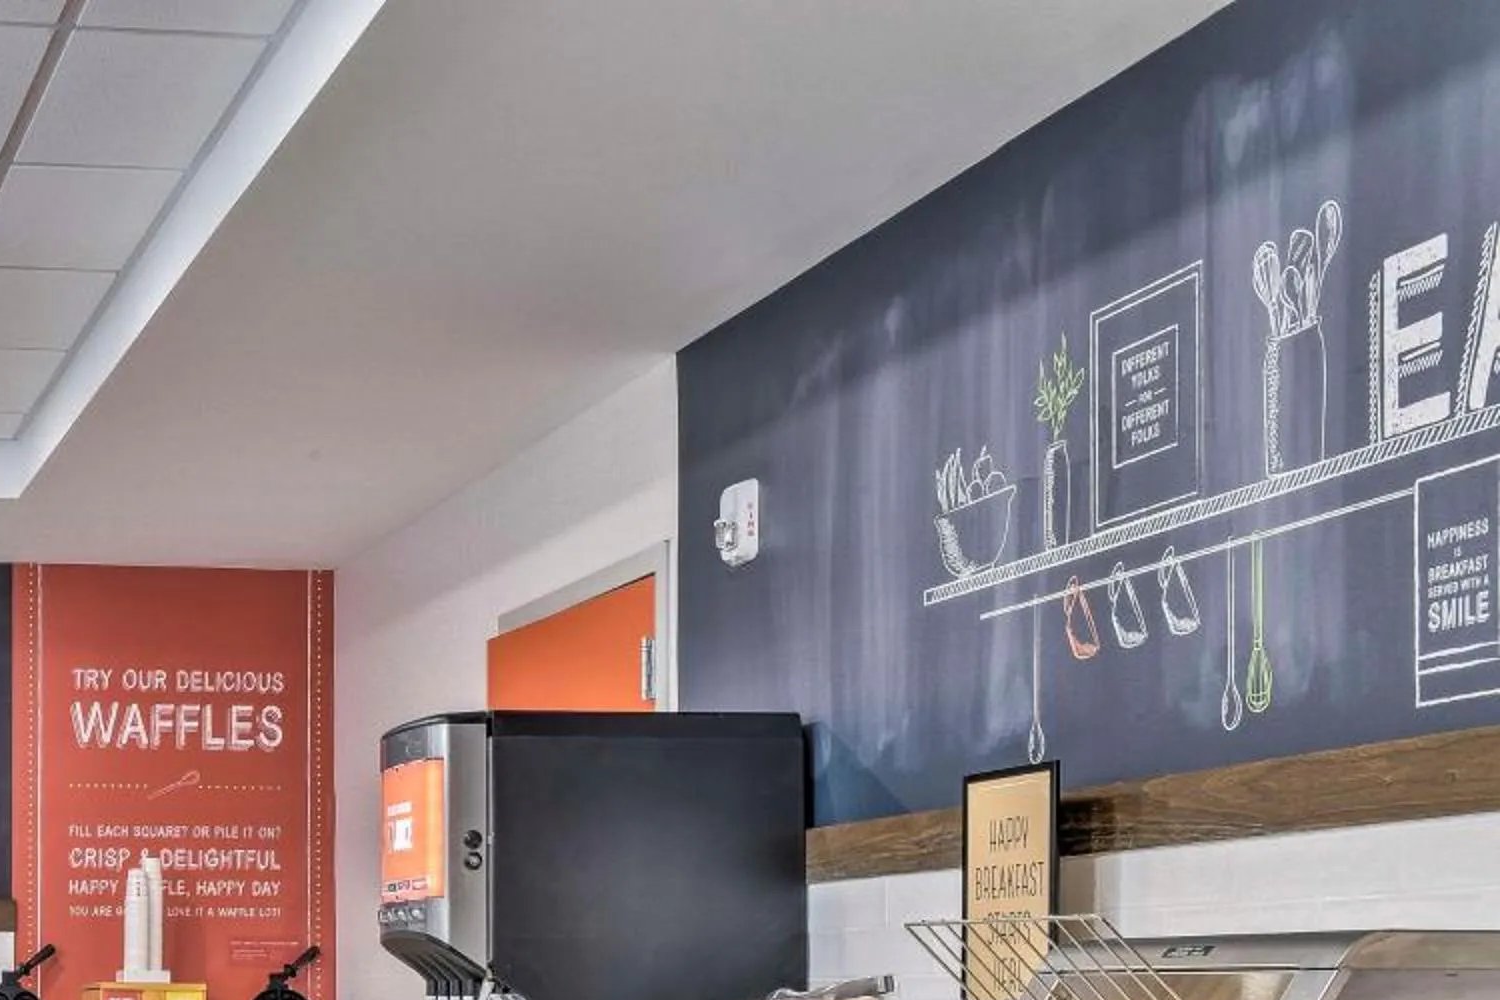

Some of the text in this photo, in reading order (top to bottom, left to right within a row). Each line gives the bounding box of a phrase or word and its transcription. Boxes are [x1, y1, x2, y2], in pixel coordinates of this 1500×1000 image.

[1121, 341, 1169, 377] DIFFERENT
[1121, 399, 1169, 432] DIFFERENT
[1131, 422, 1160, 447] FOLKS
[1427, 517, 1489, 550] HAPPINESS
[1453, 546, 1462, 558] IS
[1427, 554, 1489, 585] BREAKFAST
[1427, 574, 1489, 599] SERVED WITH A
[1427, 590, 1491, 633] SMILE
[72, 669, 285, 693] TRY OUR DELICIOUS
[70, 701, 284, 752] WAFFLES
[68, 825, 282, 839] FILL EACH SQUARE? OR PILE IT ON?
[989, 816, 1030, 852] HAPPY
[69, 848, 131, 872] CRISP
[160, 849, 281, 871] DELIGHTFUL
[68, 880, 117, 896] HAPPY
[196, 880, 245, 896] HAPPY
[252, 880, 281, 896] DAY
[975, 861, 1045, 901] BREAKFAST
[69, 905, 88, 918] YOU
[92, 905, 112, 918] ARE
[167, 905, 191, 918] LOVE
[195, 906, 203, 918] IT
[208, 906, 214, 918] A
[219, 906, 255, 918] WAFFLE
